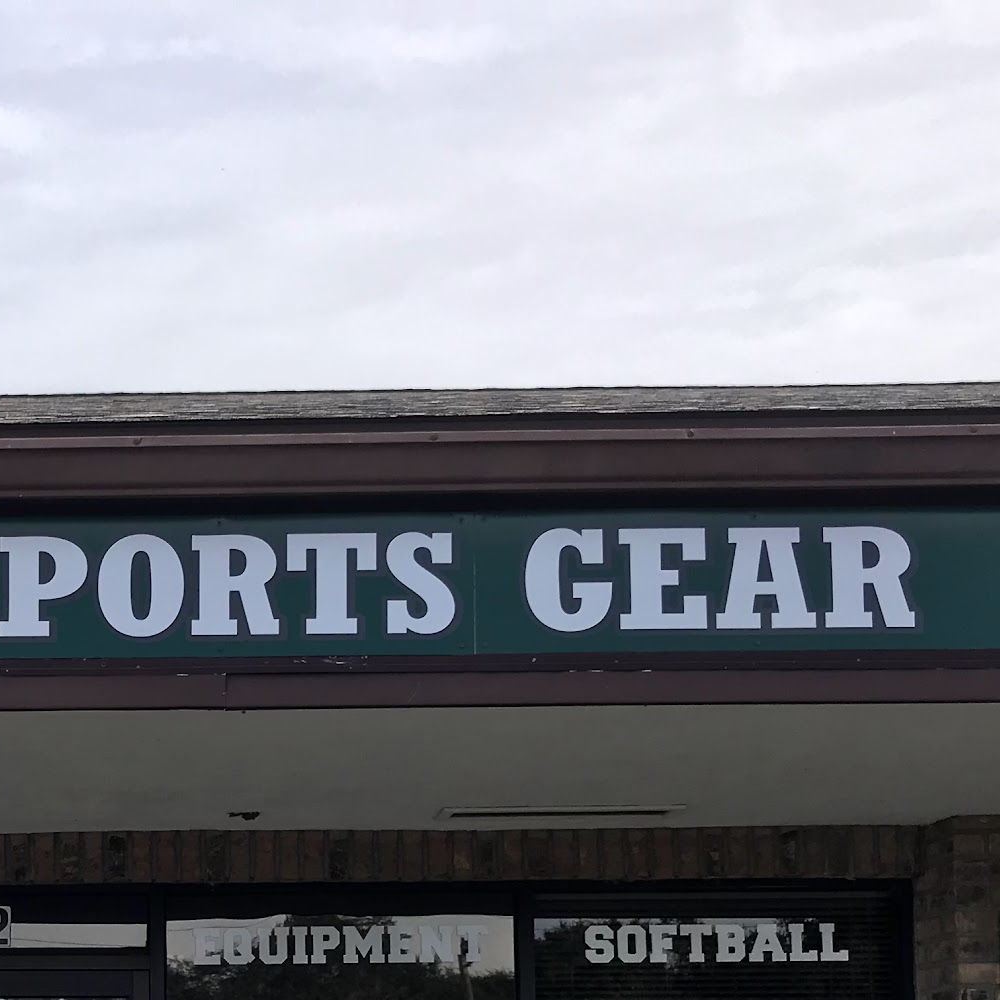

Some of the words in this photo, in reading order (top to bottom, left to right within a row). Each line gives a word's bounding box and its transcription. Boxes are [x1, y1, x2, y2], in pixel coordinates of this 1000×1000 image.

[525, 526, 916, 632] GEAR
[193, 925, 488, 966] EQUIPMENT
[584, 923, 849, 964] SOFTBALL
